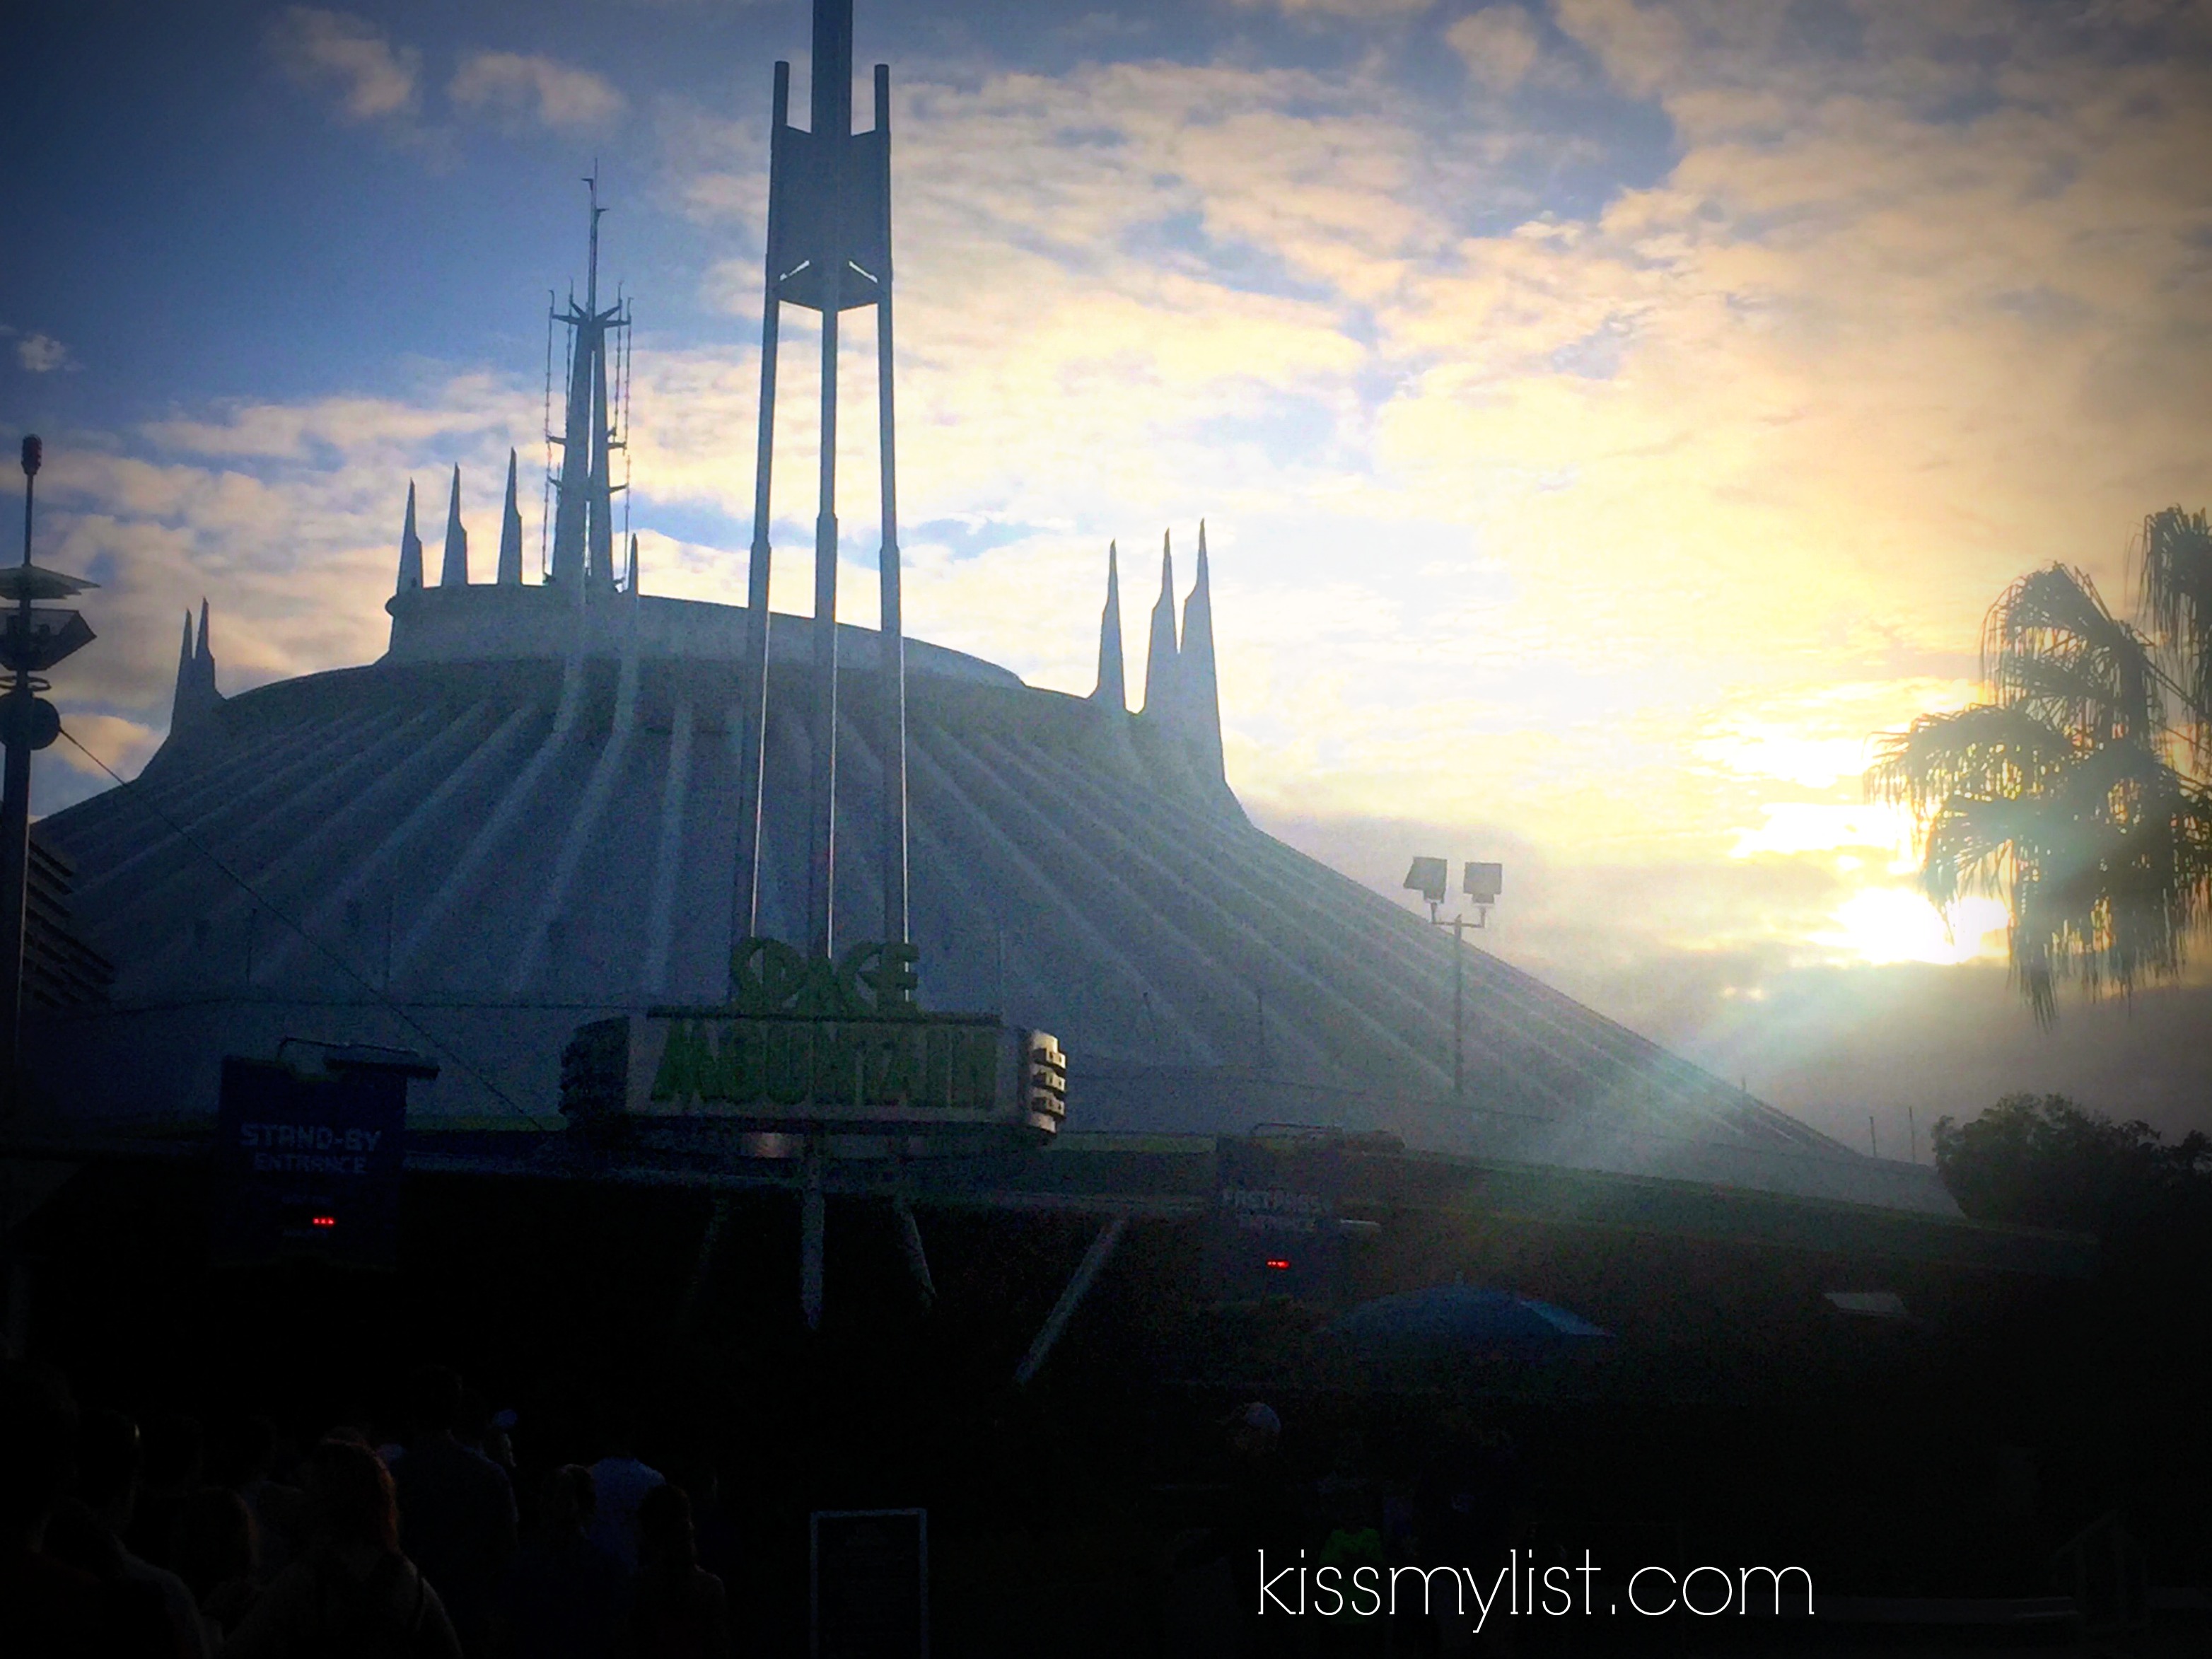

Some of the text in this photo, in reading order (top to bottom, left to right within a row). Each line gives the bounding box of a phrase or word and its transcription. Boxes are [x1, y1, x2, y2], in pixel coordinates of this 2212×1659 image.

[729, 937, 919, 1016] SPACE
[650, 1018, 997, 1109] MOUNTAIN
[240, 1122, 382, 1151] STAND-BY
